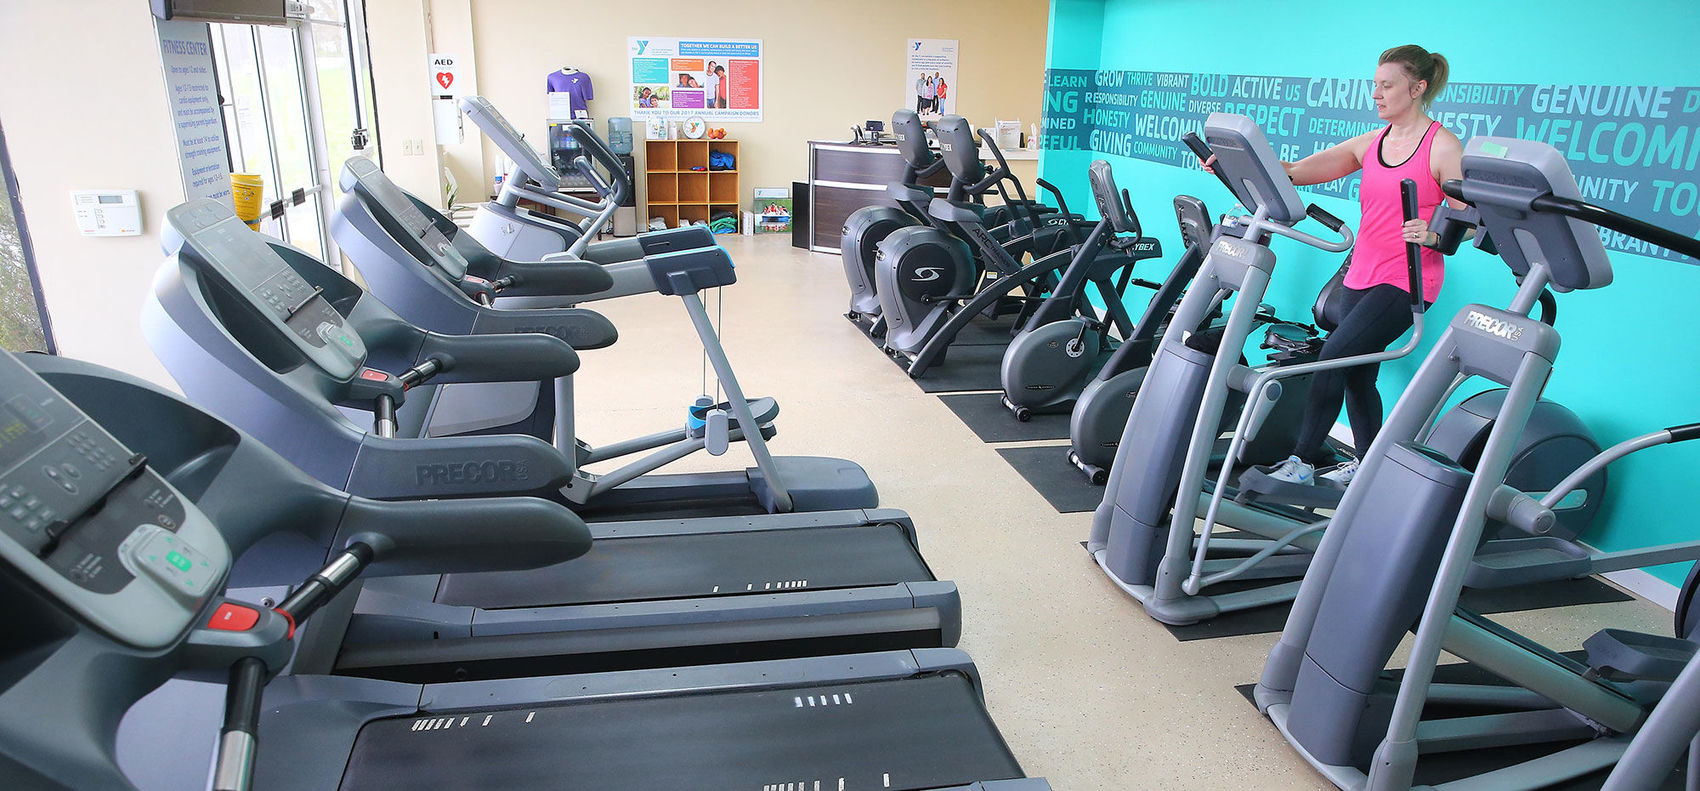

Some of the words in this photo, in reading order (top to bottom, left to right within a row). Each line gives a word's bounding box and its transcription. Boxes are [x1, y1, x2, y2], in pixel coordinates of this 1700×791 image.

[162, 39, 186, 55] FITNESS
[186, 41, 208, 56] CENTER
[1048, 76, 1088, 88] LEARN
[1095, 70, 1124, 88] GROW
[1127, 72, 1154, 86] THRIVE
[1156, 73, 1190, 88] VIBRANT
[1190, 73, 1229, 98] BOLD
[1231, 76, 1283, 100] ACTIVE
[1285, 84, 1301, 102] US
[1305, 78, 1376, 111] CARIN
[1435, 84, 1525, 106] ONSIBILITY
[1531, 85, 1675, 119] GENUINE
[1083, 108, 1131, 129] HONESTY
[1135, 113, 1206, 142] WELCOMIN
[1084, 92, 1138, 107] RESPONSIBILITY
[1140, 89, 1187, 112] GENUINE
[1188, 100, 1222, 114] DIVERSE
[1308, 117, 1386, 138] DETERMIN
[1089, 129, 1132, 157] GIVING
[1133, 141, 1178, 160] COMMUNITY
[1132, 243, 1155, 251] YBEX
[1463, 310, 1517, 340] PRECOR
[415, 459, 513, 485] PRECOR
